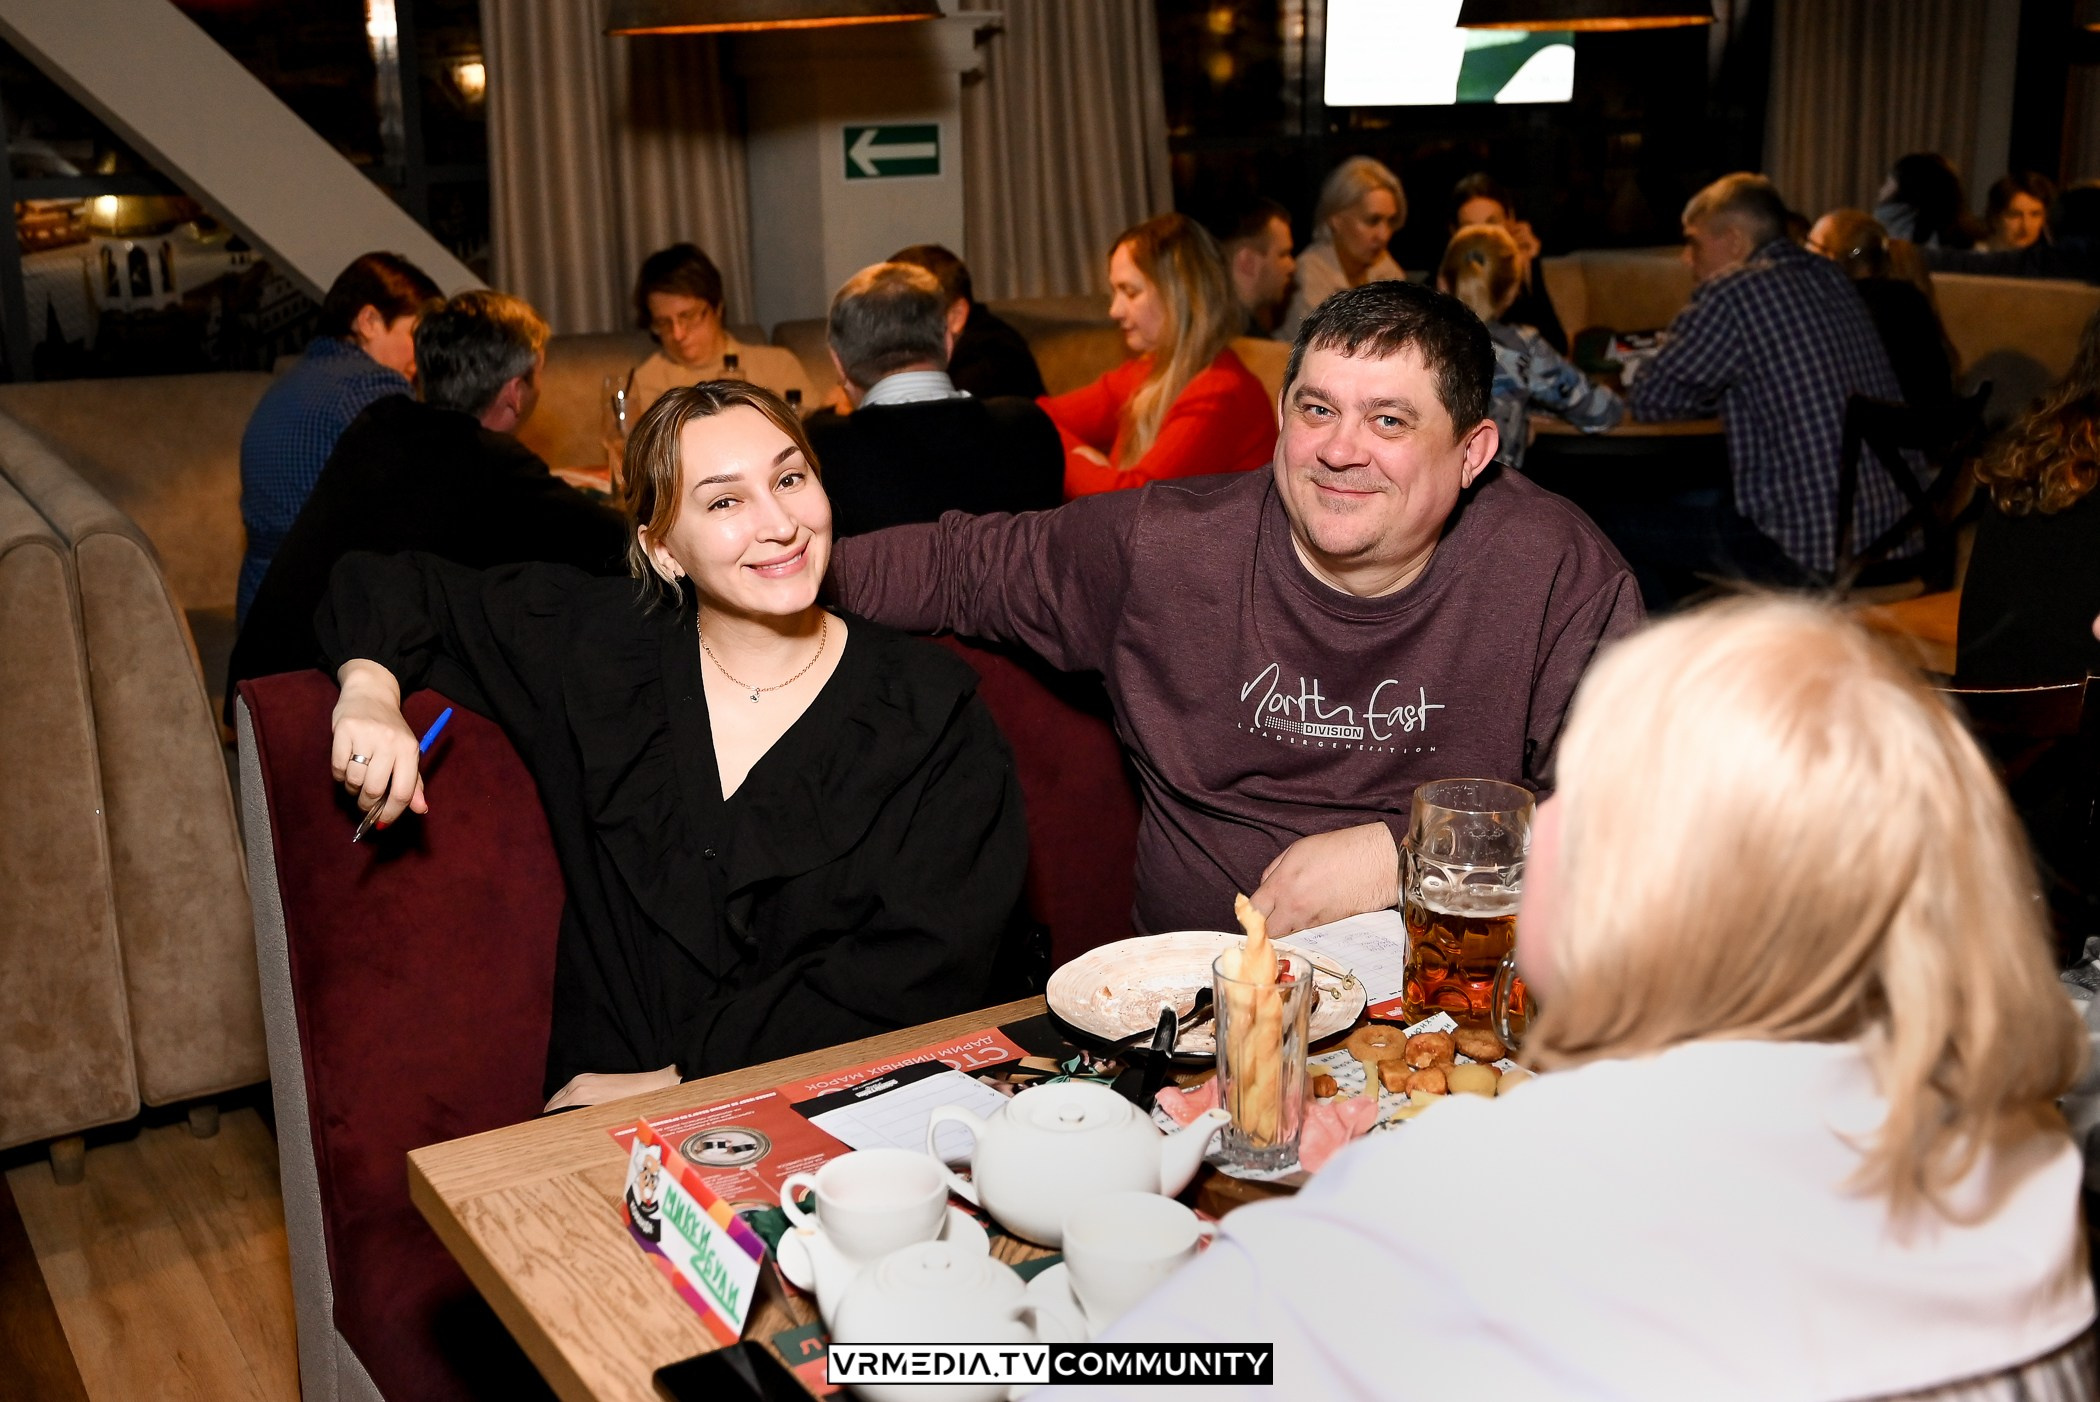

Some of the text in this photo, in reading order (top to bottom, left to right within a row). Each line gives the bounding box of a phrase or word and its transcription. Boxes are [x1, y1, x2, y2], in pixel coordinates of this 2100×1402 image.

[1240, 662, 1445, 741] North East
[1305, 723, 1362, 739] DIVISION
[939, 1035, 994, 1058] ДАРИМ
[867, 1052, 937, 1076] ПИВНЫХ
[804, 1071, 864, 1092] МАРОК
